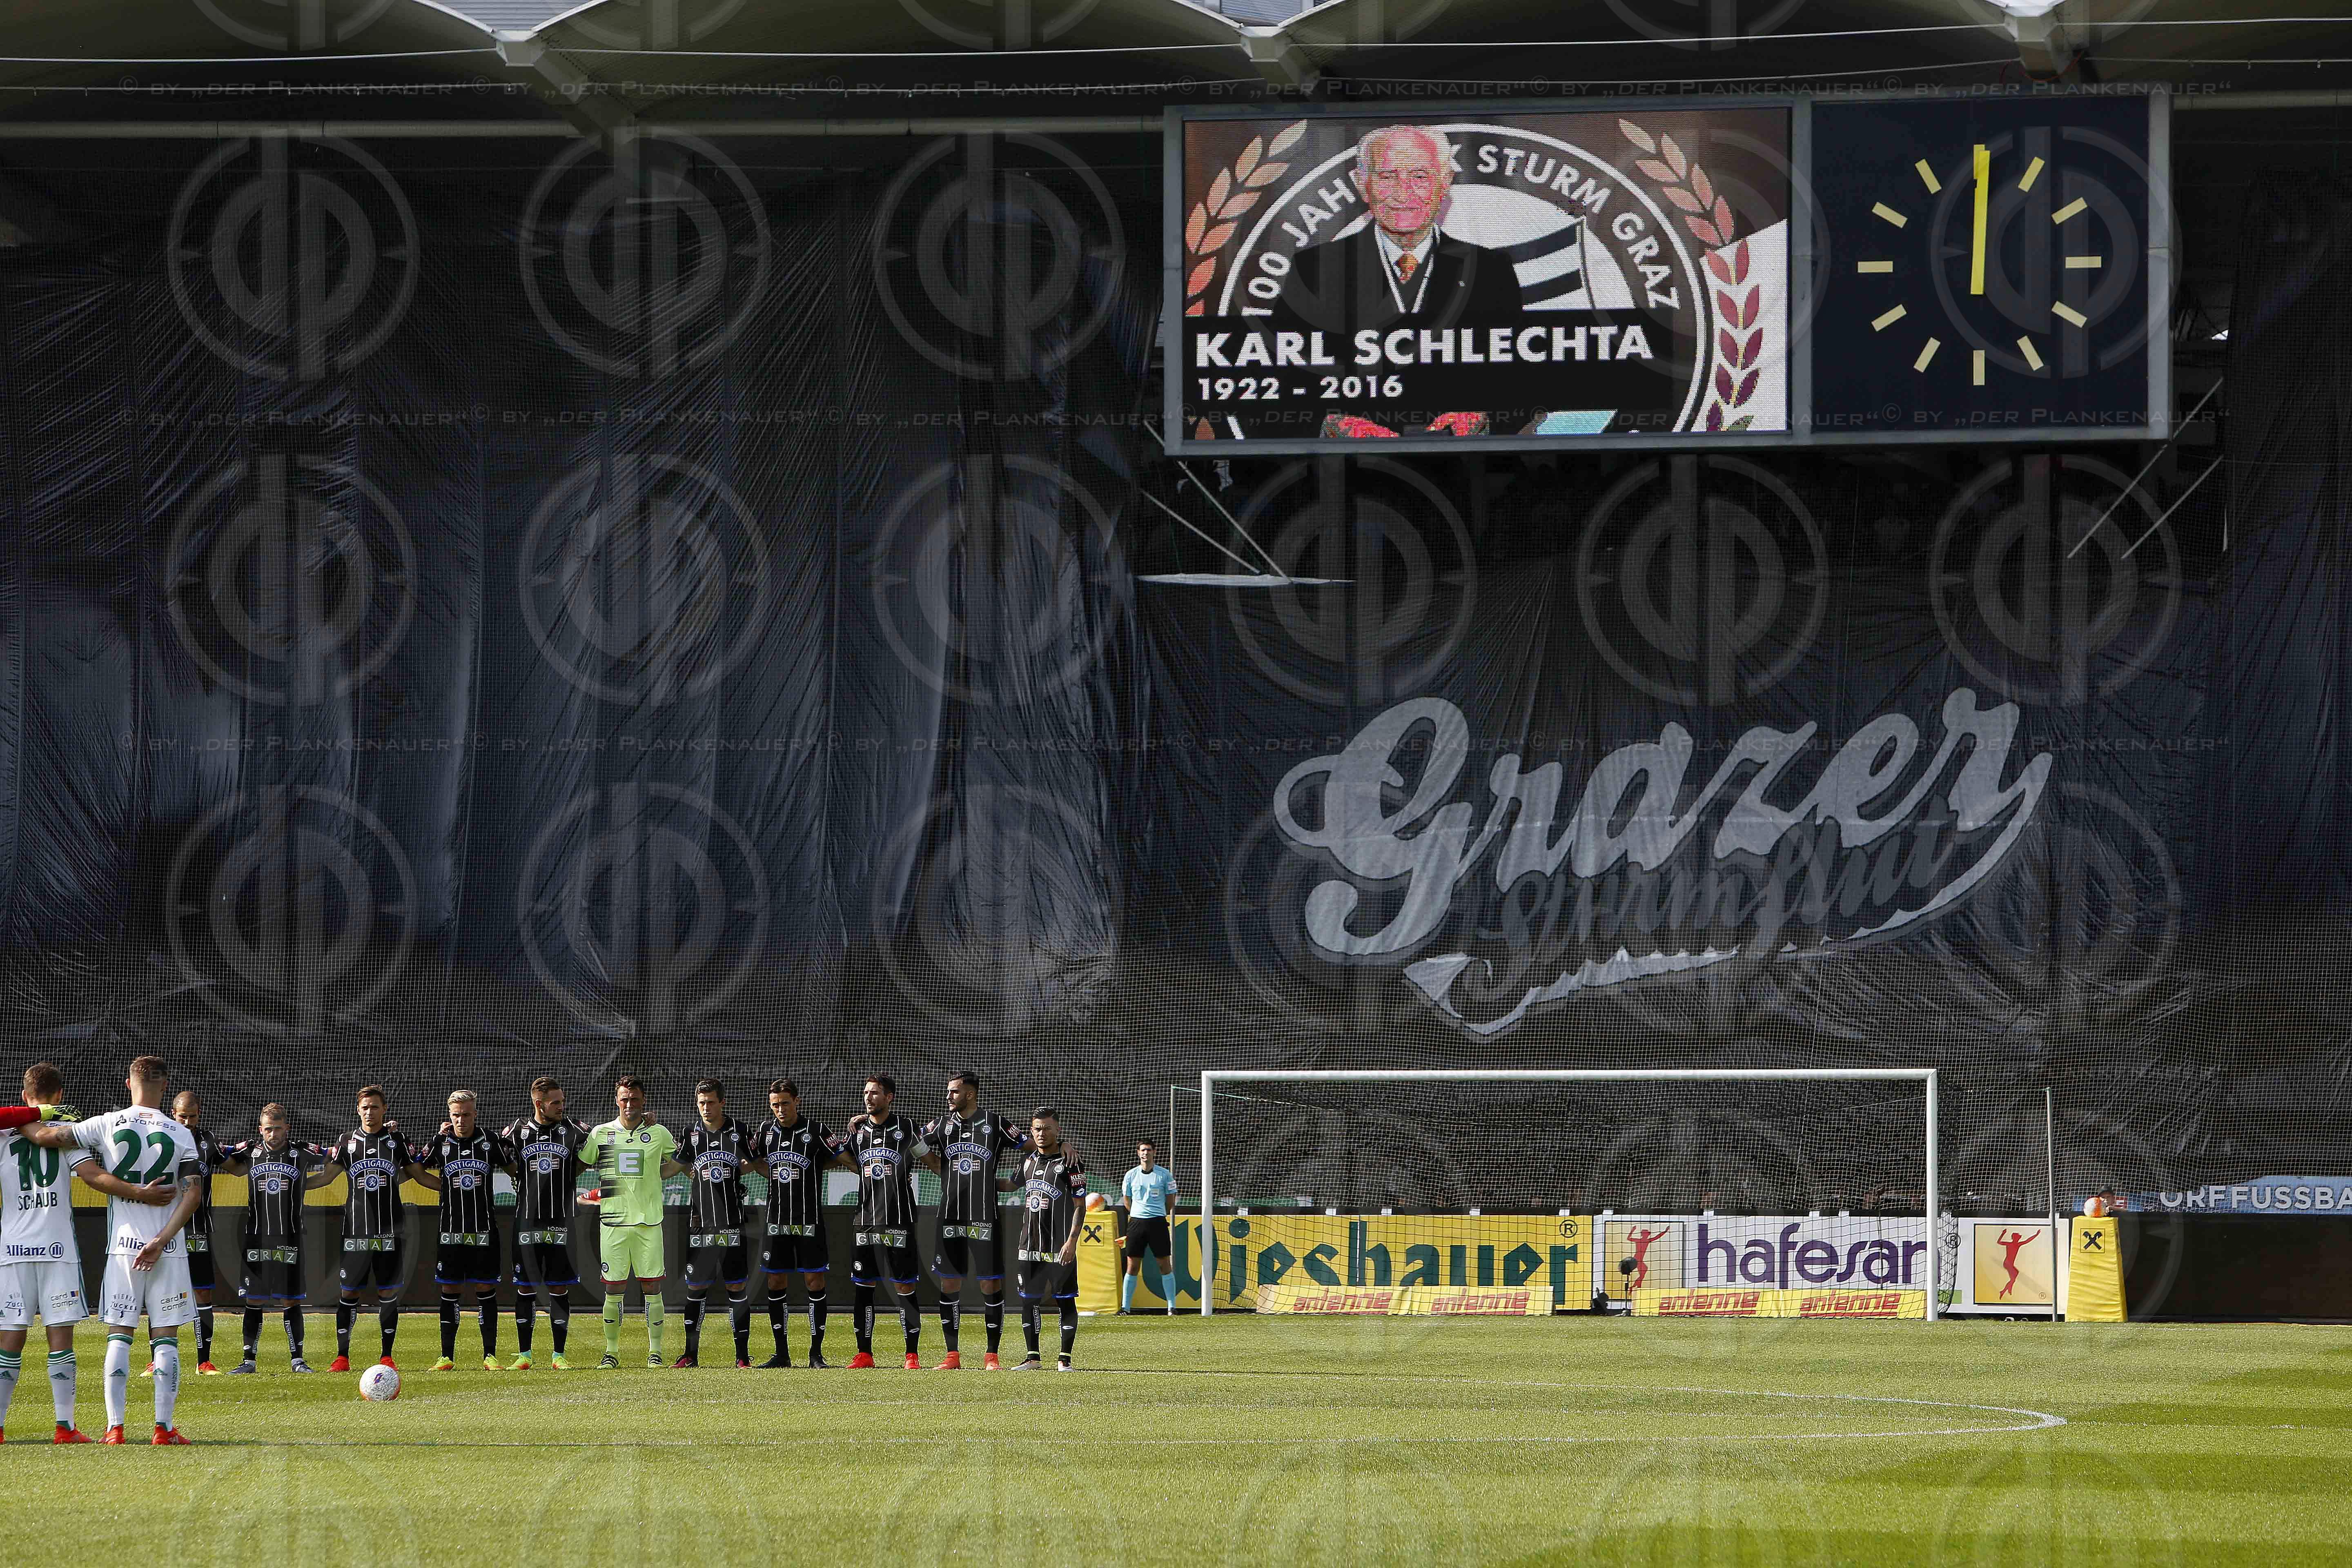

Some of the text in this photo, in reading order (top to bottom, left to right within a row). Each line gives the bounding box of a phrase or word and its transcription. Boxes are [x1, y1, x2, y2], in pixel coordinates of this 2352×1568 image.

[1242, 251, 1291, 316] 100
[1282, 169, 1367, 247] JAH
[1477, 144, 1612, 214] STURM
[1612, 212, 1680, 310] GRAZ
[1196, 324, 1654, 368] KARL SCHLECHTA
[1197, 376, 1280, 401] 1922
[1320, 374, 1404, 399] 2016
[1273, 687, 2054, 956] Grazer
[129, 1118, 176, 1131] LYONESS
[112, 1129, 175, 1185] 22
[522, 1144, 568, 1158] PUNTIGAMER
[859, 1149, 900, 1163] PUNTIGAMER
[946, 1144, 990, 1159] PUNTIGAMER
[9, 1137, 59, 1191] 10
[445, 1161, 489, 1174] PUNTIGAMER
[619, 1153, 640, 1173] E
[694, 1152, 738, 1169] PUNTIGAMER
[250, 1164, 298, 1178] PUNTIGAMER
[351, 1160, 394, 1176] PUNTIGAMER
[1025, 1181, 1058, 1198] UNTIGAMER
[769, 1225, 812, 1236] GRAZ
[944, 1227, 989, 1239] GRAZ
[118, 1237, 147, 1250] Allia
[441, 1234, 487, 1245] GRAZ
[520, 1232, 566, 1244] GRAZ
[691, 1235, 739, 1246] GRAZ
[858, 1234, 905, 1247] GRAZ
[7, 1245, 46, 1256] Allianz
[186, 1241, 206, 1251] AZ
[345, 1240, 393, 1251] GRAZ
[248, 1251, 295, 1263] GRAZ
[1698, 1223, 1940, 1289] hafesan
[1294, 1288, 1392, 1311] antenne
[1431, 1287, 1531, 1312] antenne
[1659, 1288, 1760, 1311] antenne
[1800, 1289, 1901, 1312] antenne
